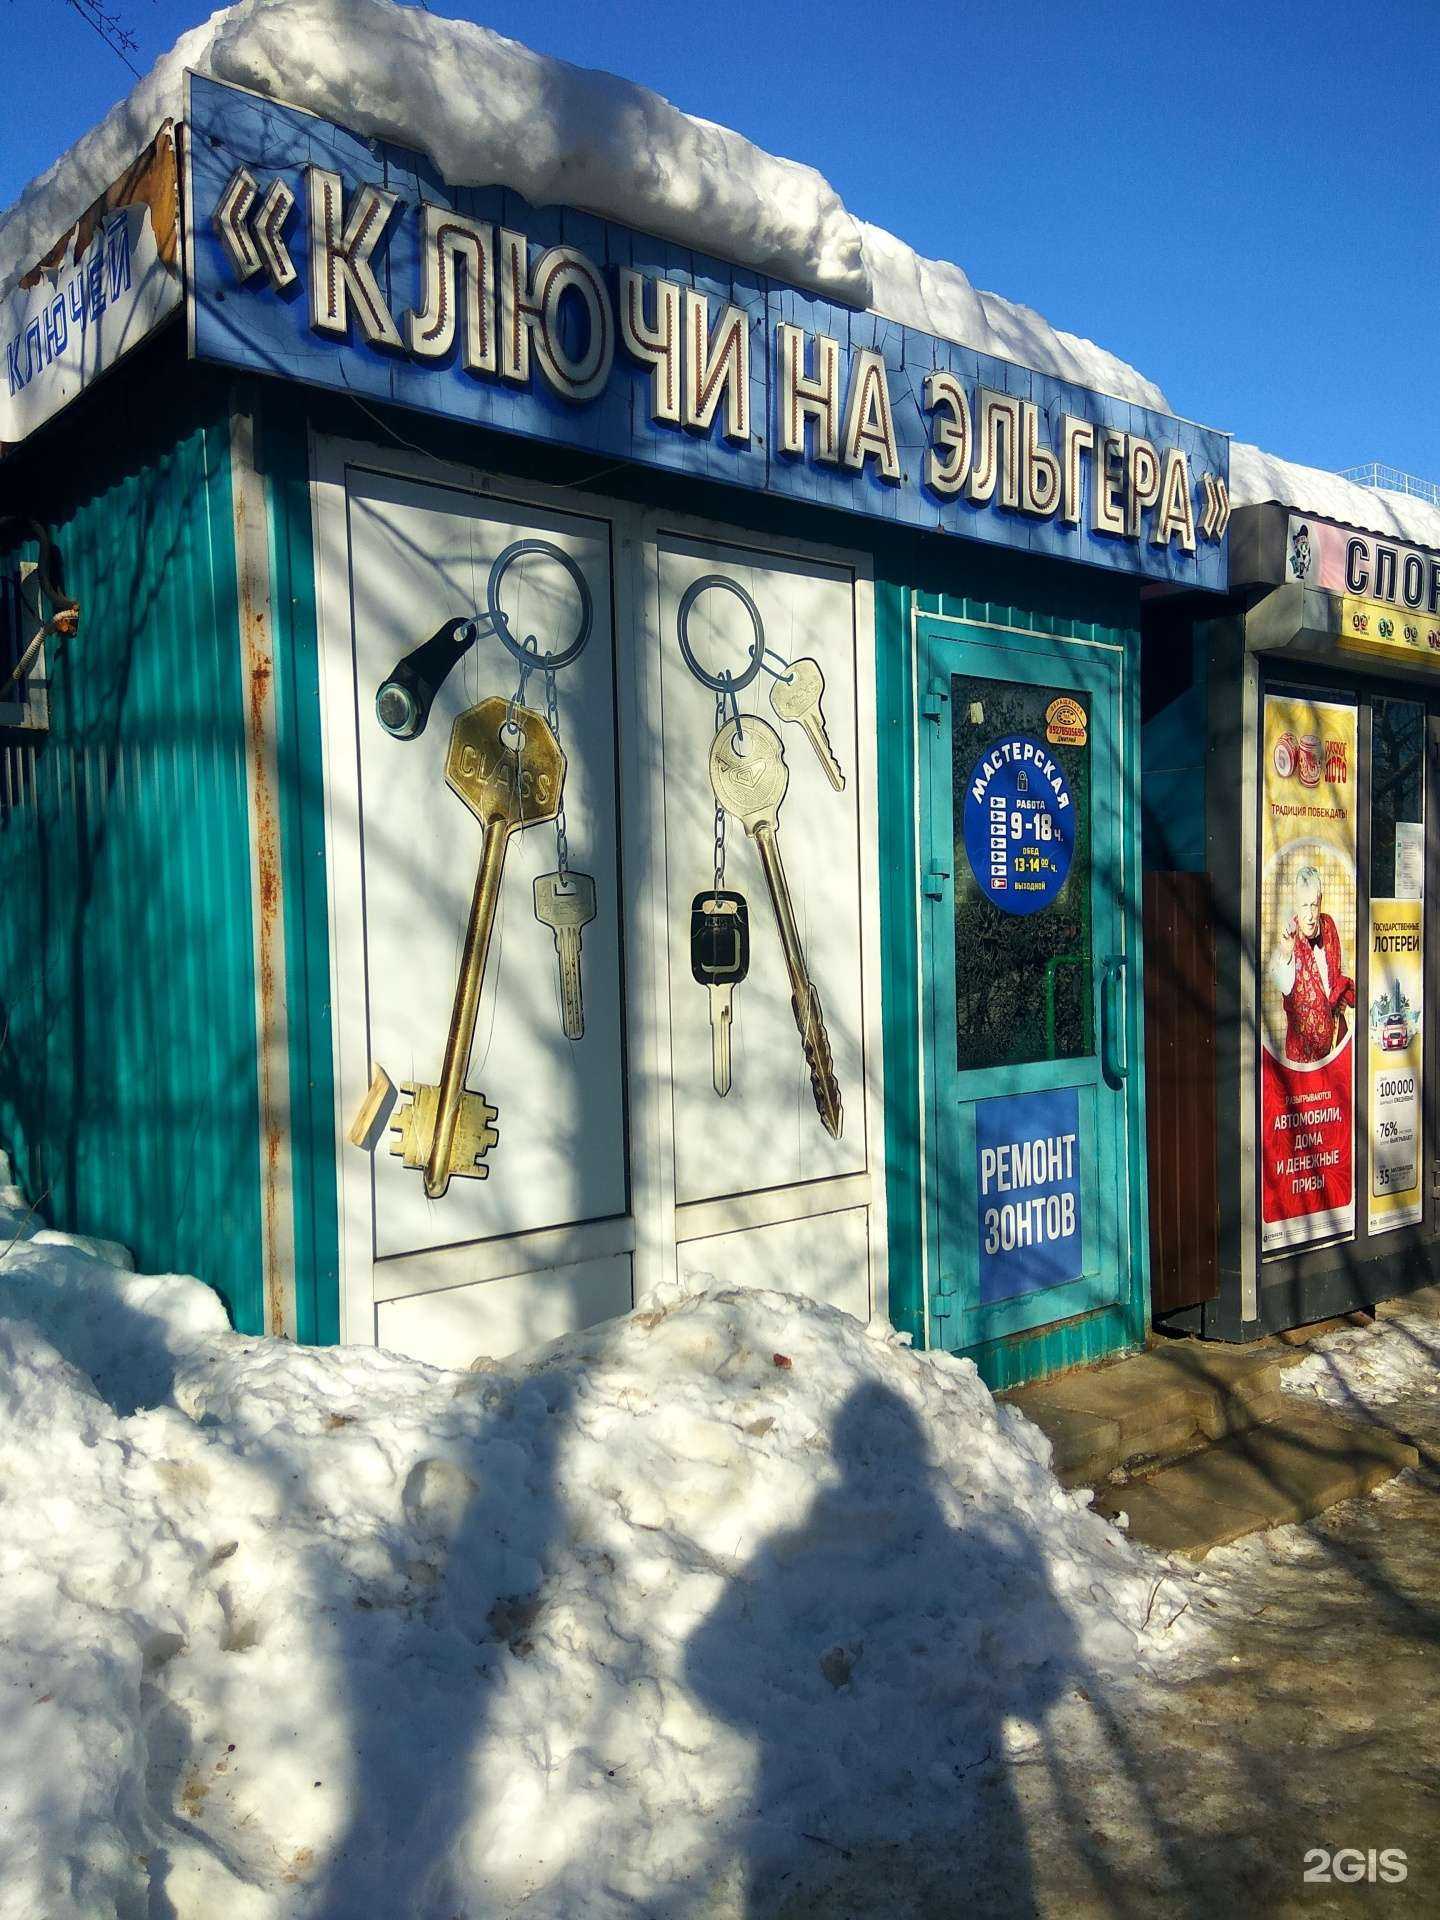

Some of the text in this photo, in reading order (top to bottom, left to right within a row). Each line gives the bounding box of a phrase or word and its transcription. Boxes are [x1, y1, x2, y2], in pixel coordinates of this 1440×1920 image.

[6, 210, 131, 397] КЛЮЧЕЙ
[776, 320, 902, 487] НА
[459, 744, 551, 804] CLASS
[972, 742, 1070, 810] МАСТЕРСКАЯ
[1016, 800, 1046, 809] РАБОТА
[1271, 803, 1348, 821] ТРАДИЦИЯ ПОБЕЖДАТЬ!
[1010, 812, 1053, 841] 9-18
[1022, 847, 1040, 856] ОБЕД
[1014, 882, 1046, 891] ВЫХОДНОЙ
[1373, 935, 1420, 953] ЛОТЕРЕИ
[1285, 1091, 1332, 1105] РАЗЫГРЫВАЮТСЯ
[1274, 1106, 1342, 1131] АВТОМОБИЛИ,
[1380, 1121, 1398, 1138] 76%
[1294, 1132, 1323, 1151] ДОМА
[981, 1134, 1076, 1195] РЕМОНТ
[1276, 1149, 1340, 1176] И ДЕНЕЖНЫЕ
[1292, 1174, 1325, 1195] ПРИЗЫ
[1379, 1168, 1390, 1186] 35
[984, 1192, 1076, 1255] ЗОНТОВ
